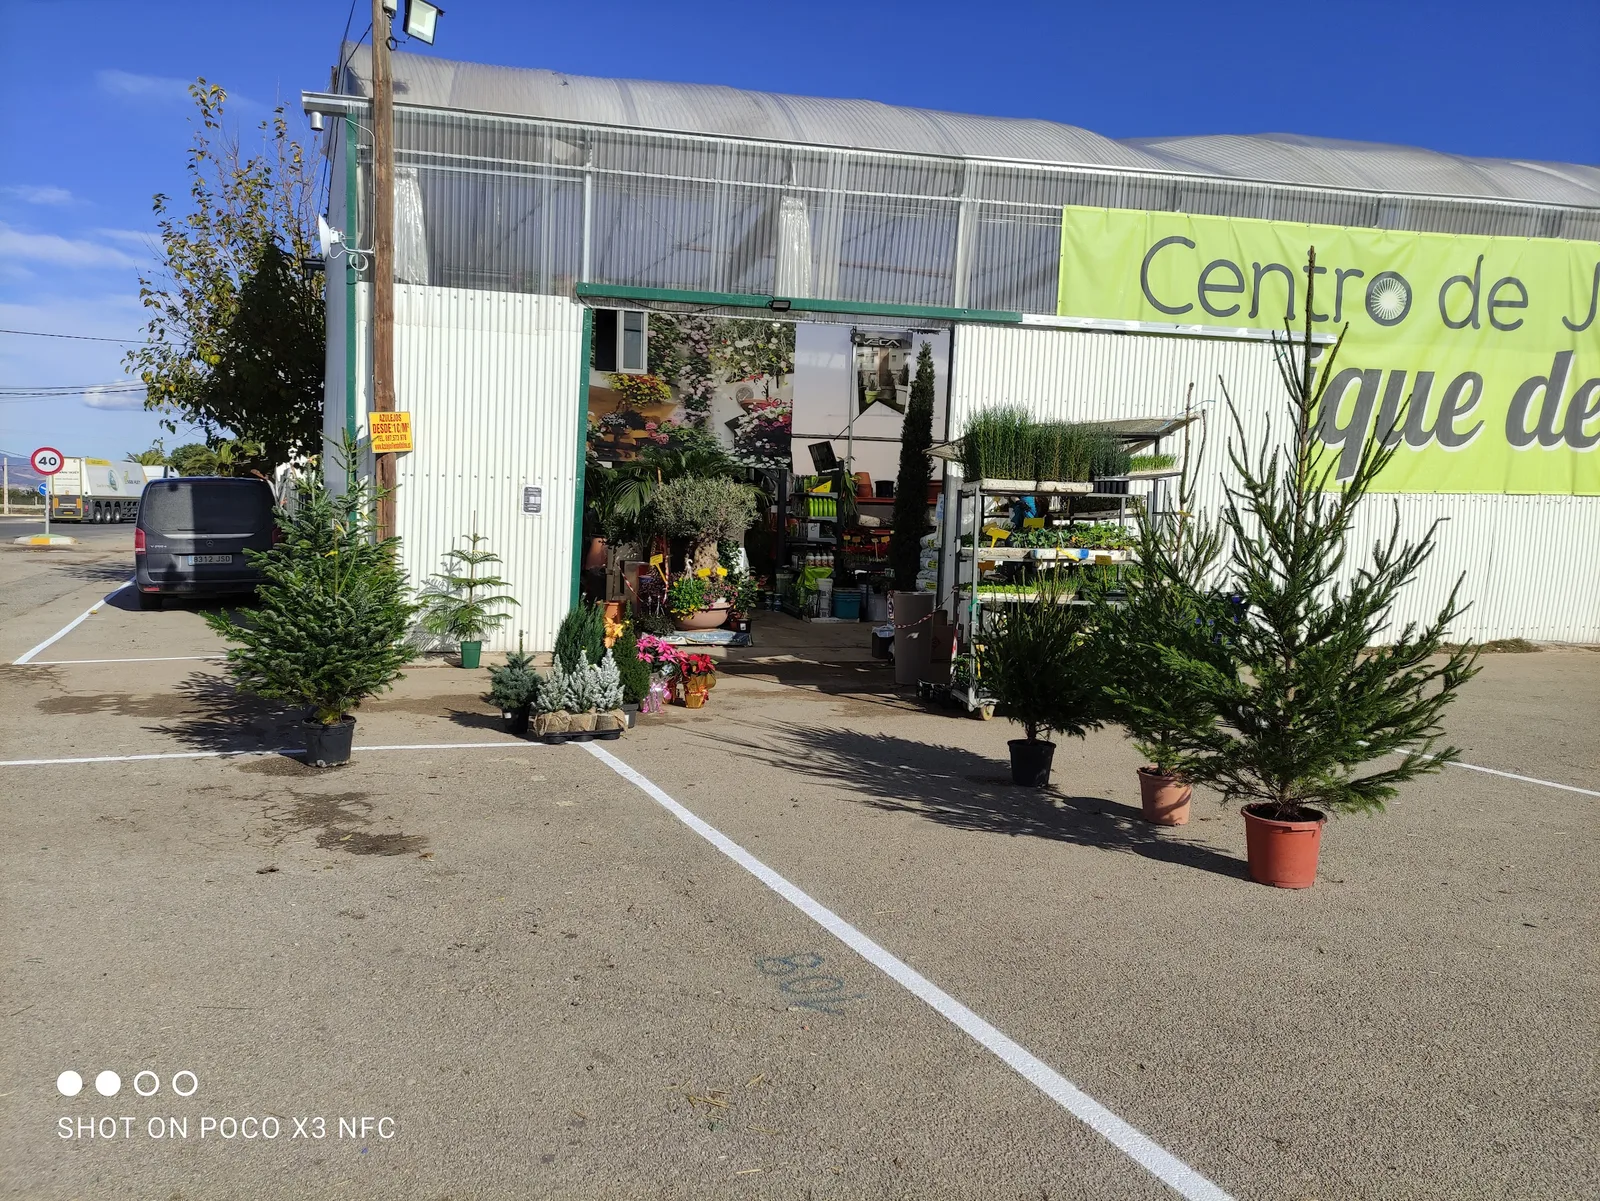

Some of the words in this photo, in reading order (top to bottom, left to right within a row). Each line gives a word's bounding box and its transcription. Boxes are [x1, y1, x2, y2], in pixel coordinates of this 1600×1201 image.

[1140, 236, 1413, 327] Centro
[1438, 254, 1529, 331] de
[1505, 350, 1600, 452] de
[372, 423, 391, 434] DESDE
[38, 457, 57, 466] 40
